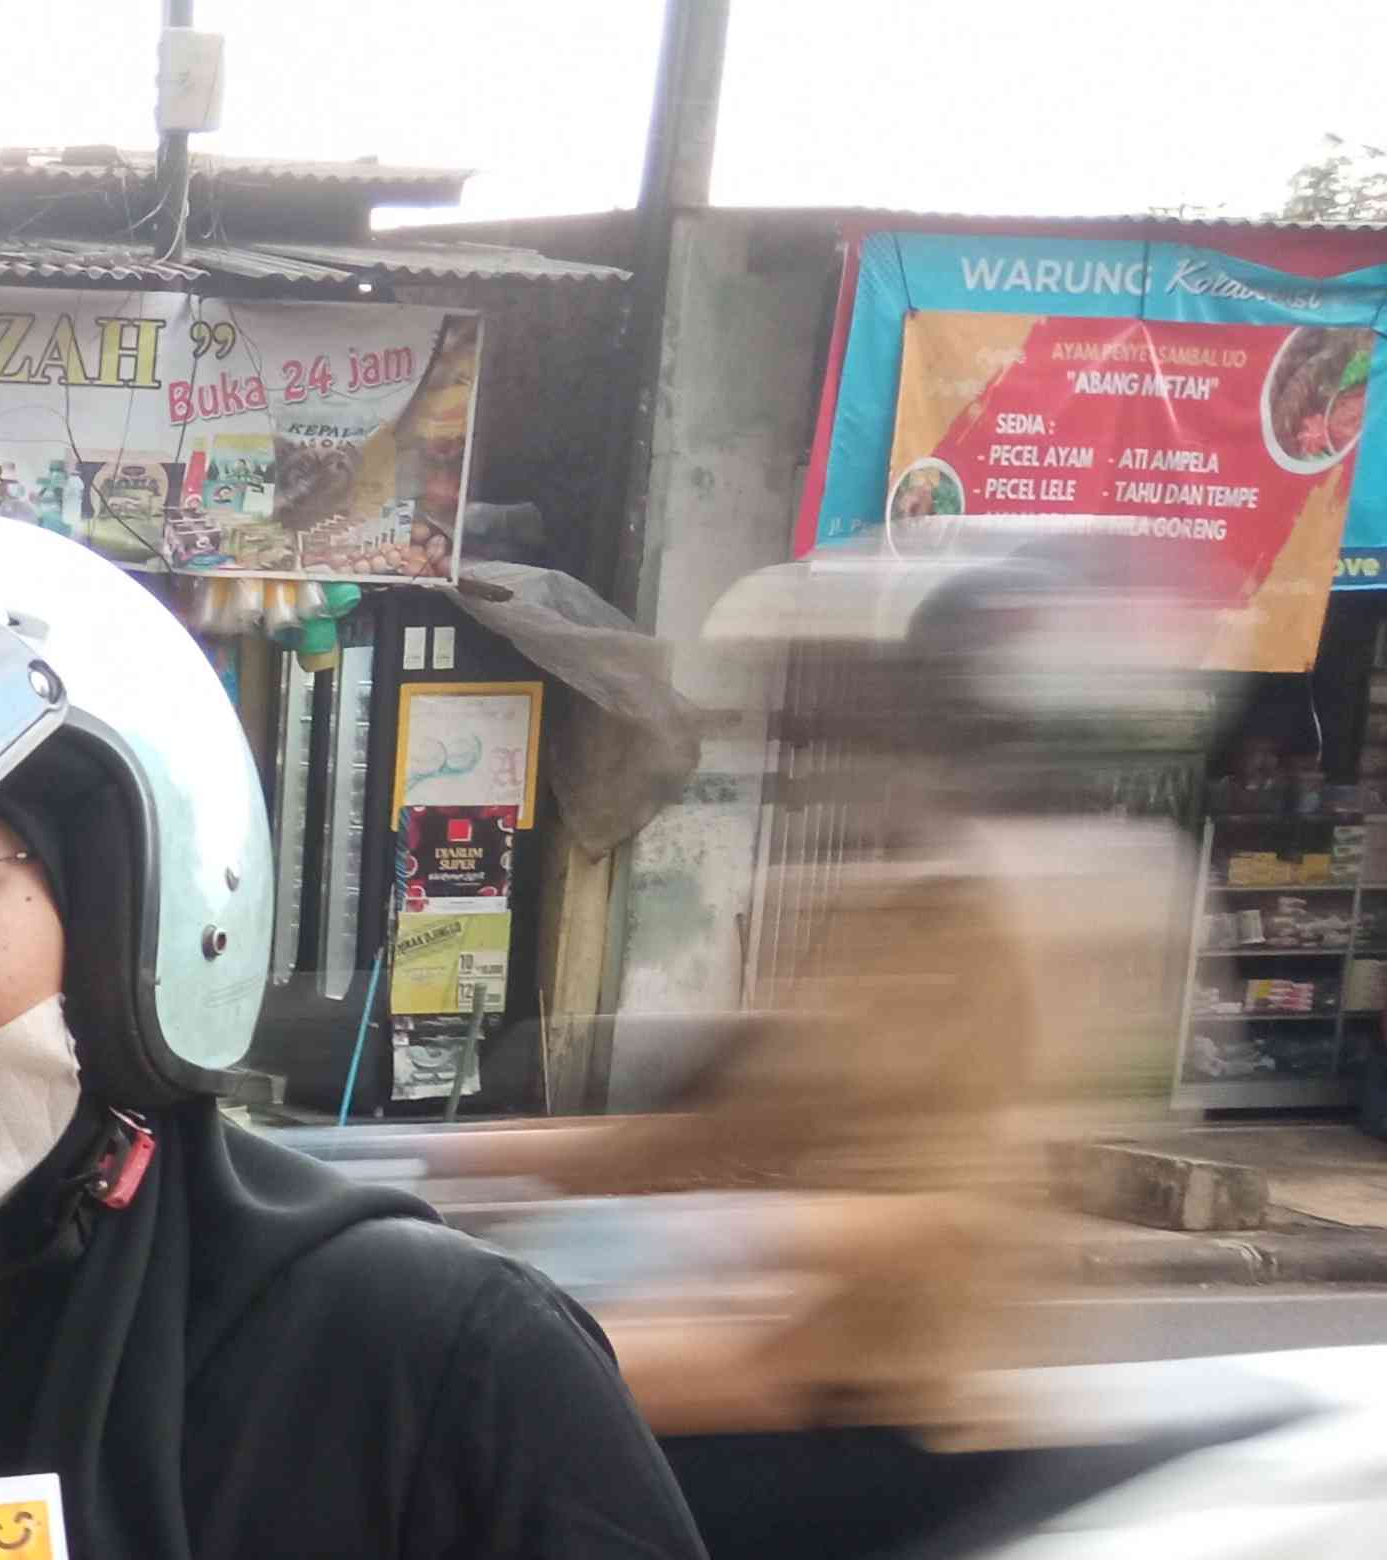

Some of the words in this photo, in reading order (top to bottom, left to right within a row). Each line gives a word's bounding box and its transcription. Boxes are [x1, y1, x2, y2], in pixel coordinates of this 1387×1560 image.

[961, 256, 1152, 296] WARUNG
[1051, 341, 1098, 362] AYAM
[1156, 345, 1219, 367] SAMBAL
[167, 373, 267, 427] Buka
[282, 354, 334, 403] 24
[346, 343, 415, 395] jam
[988, 444, 1040, 468] PECEL
[1043, 446, 1095, 469] AYAM
[1117, 448, 1148, 470] ATI
[1149, 450, 1220, 474] AMPELA
[984, 478, 1038, 500] PECEL
[1039, 478, 1076, 501] LELE
[1114, 480, 1162, 504] TAHU
[1164, 483, 1205, 506] DAN
[1206, 485, 1260, 508] TEMPE
[1153, 516, 1228, 541] GORENG
